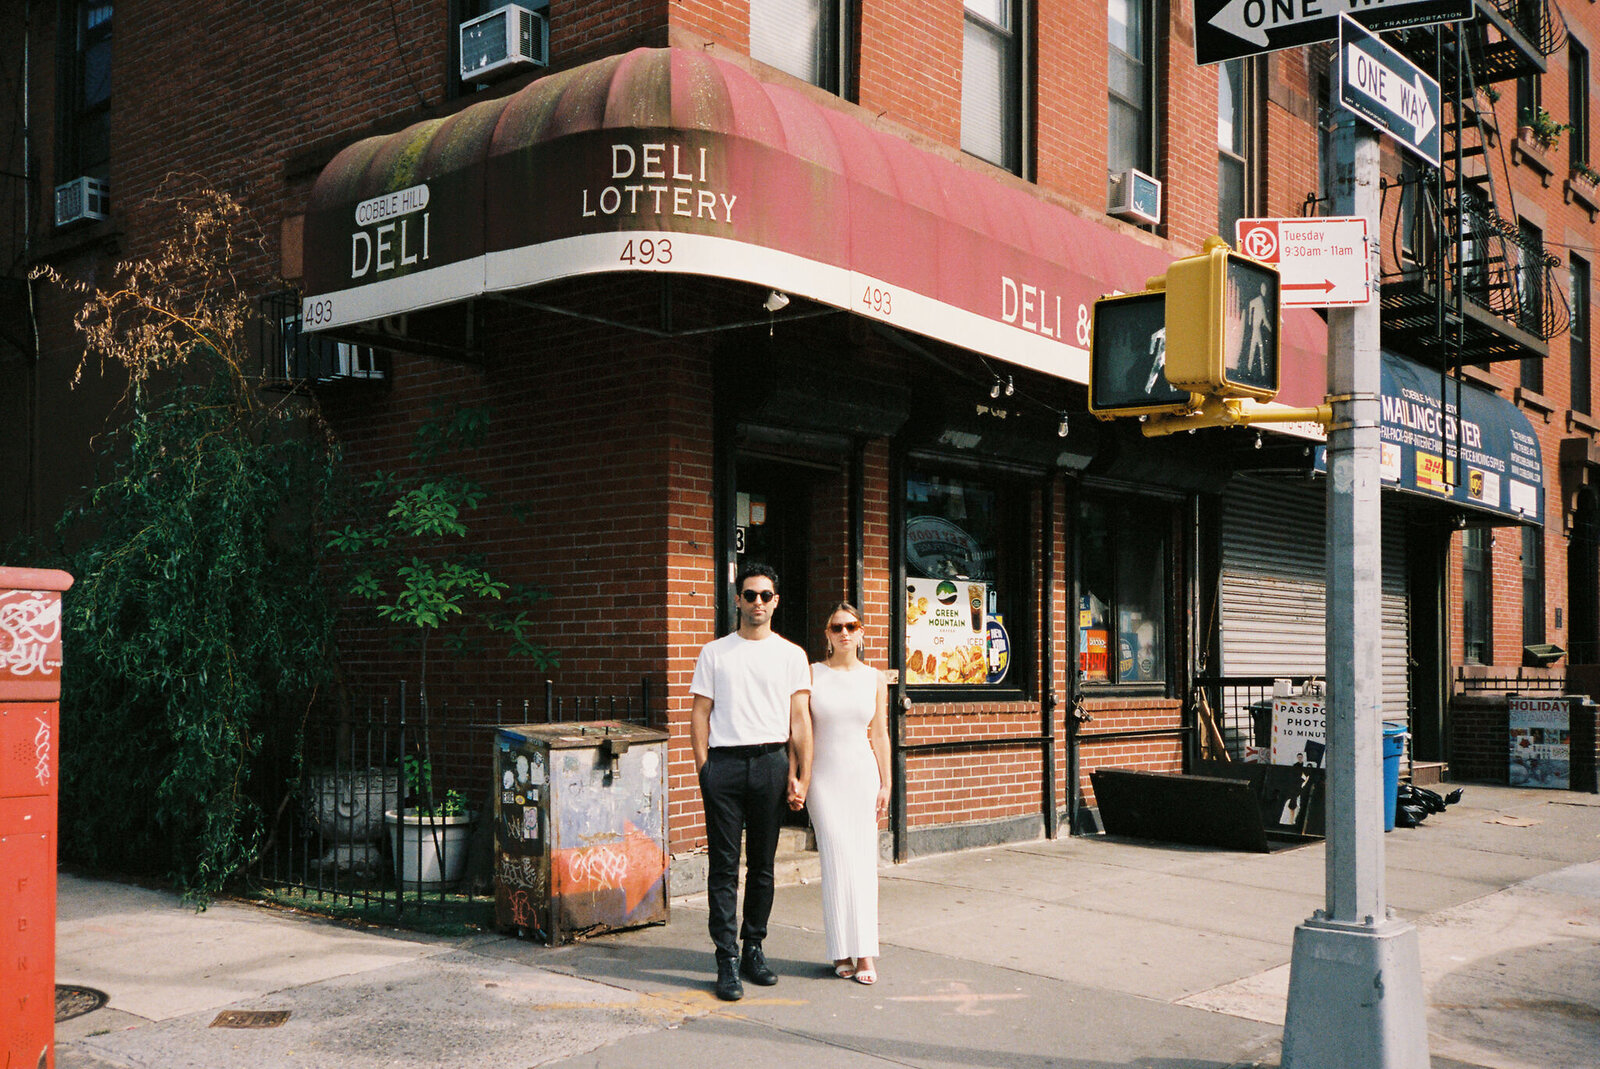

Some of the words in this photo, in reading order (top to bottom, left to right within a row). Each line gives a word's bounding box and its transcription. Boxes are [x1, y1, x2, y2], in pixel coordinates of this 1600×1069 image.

[1384, 12, 1462, 27] TRANSPORTATION
[1358, 55, 1387, 102] ONE
[1400, 83, 1427, 128] WAY
[611, 143, 707, 182] DELI
[359, 196, 398, 223] COBBLE
[402, 189, 424, 211] HILL
[582, 185, 737, 223] LOTTERY
[351, 212, 430, 279] DELI
[1284, 230, 1325, 242] Tuesday
[619, 238, 673, 265] 493
[1284, 246, 1321, 257] 9:30am
[1331, 245, 1353, 256] 11am
[862, 286, 892, 316] 493
[1001, 276, 1061, 339] DELI
[305, 300, 333, 326] 493
[1381, 394, 1435, 434] MAILING
[1436, 411, 1481, 448] CENTER
[1425, 458, 1443, 474] DH
[928, 618, 966, 627] MOUNTAIN
[935, 609, 959, 617] GREEN
[933, 636, 945, 645] OR
[967, 637, 984, 646] ICED
[1280, 705, 1327, 715] PASSPO
[1510, 700, 1569, 712] HOLIDAY
[1287, 718, 1327, 728] PHOTO
